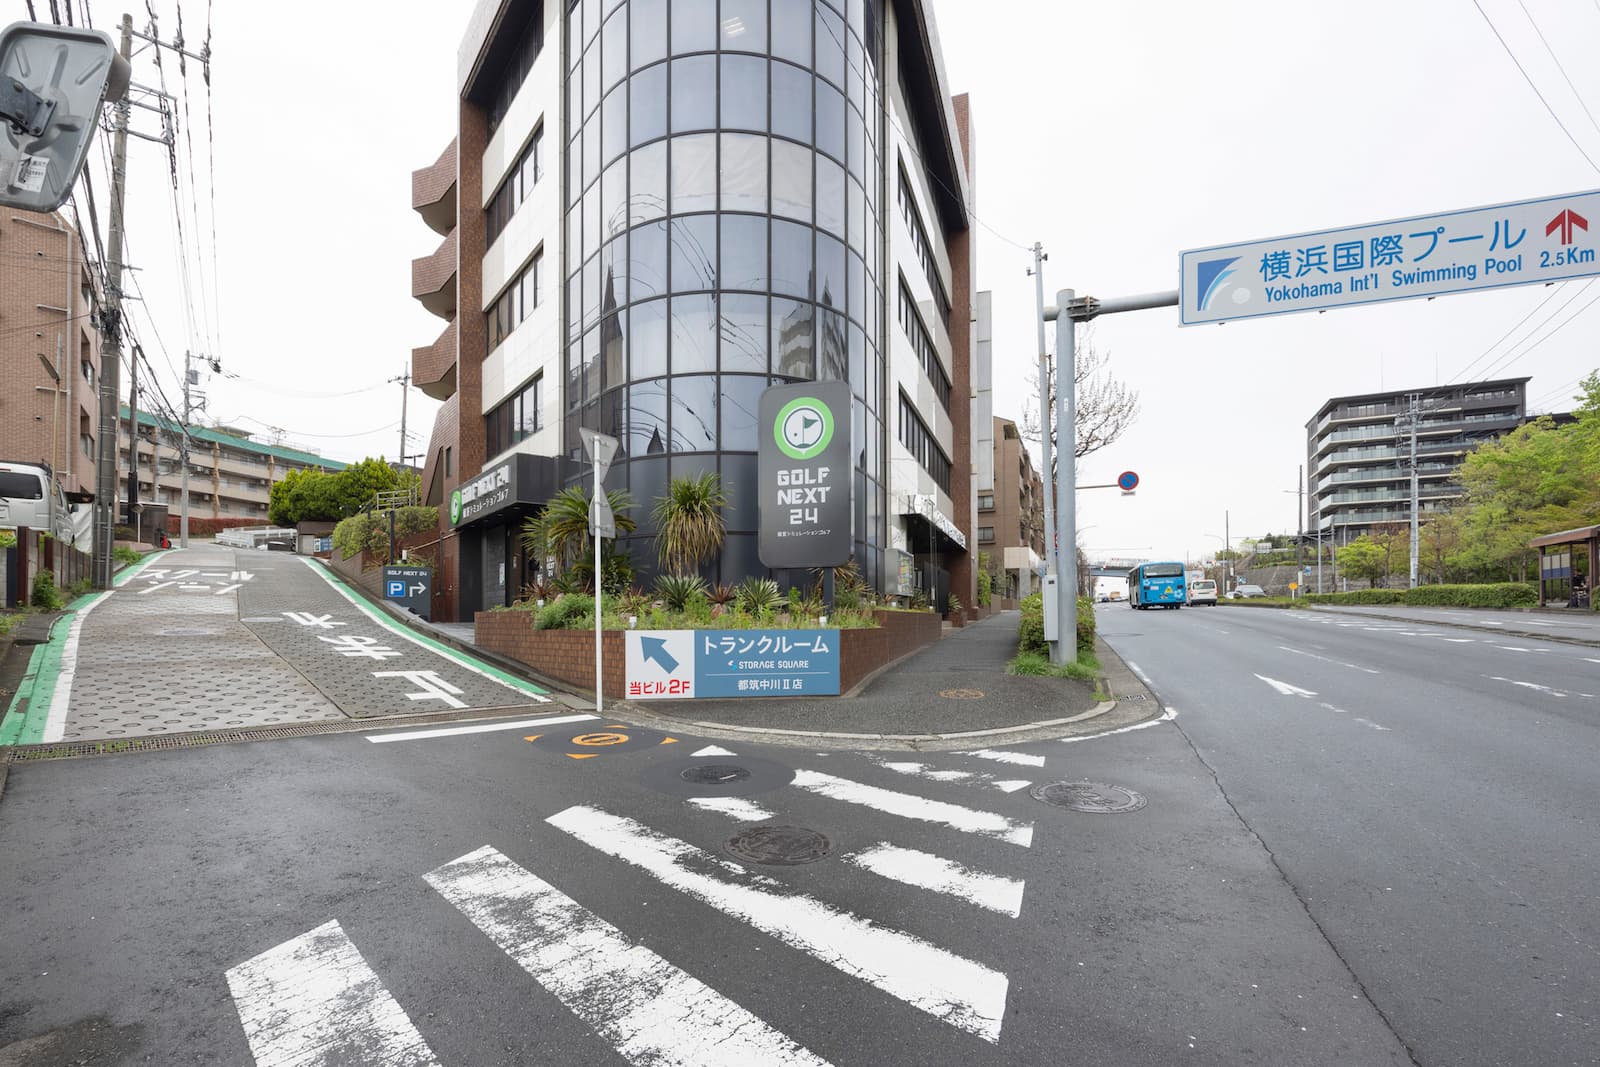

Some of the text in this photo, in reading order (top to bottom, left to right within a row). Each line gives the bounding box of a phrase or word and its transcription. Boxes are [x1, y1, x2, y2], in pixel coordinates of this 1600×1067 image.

[1259, 219, 1526, 282] 横浜国際プール
[1265, 282, 1342, 302] Yokohama
[1392, 263, 1477, 287] Swimming
[1485, 254, 1522, 275] Pool
[777, 467, 830, 486] GOLF
[777, 487, 831, 505] NEXT
[790, 508, 818, 525] 24
[135, 569, 255, 580] スクール
[137, 581, 243, 594] ゾーン
[390, 582, 403, 595] P
[704, 635, 830, 655] トランクルーム
[738, 660, 809, 669] STORAGE SQUARE
[629, 679, 690, 695] 当ビル2F
